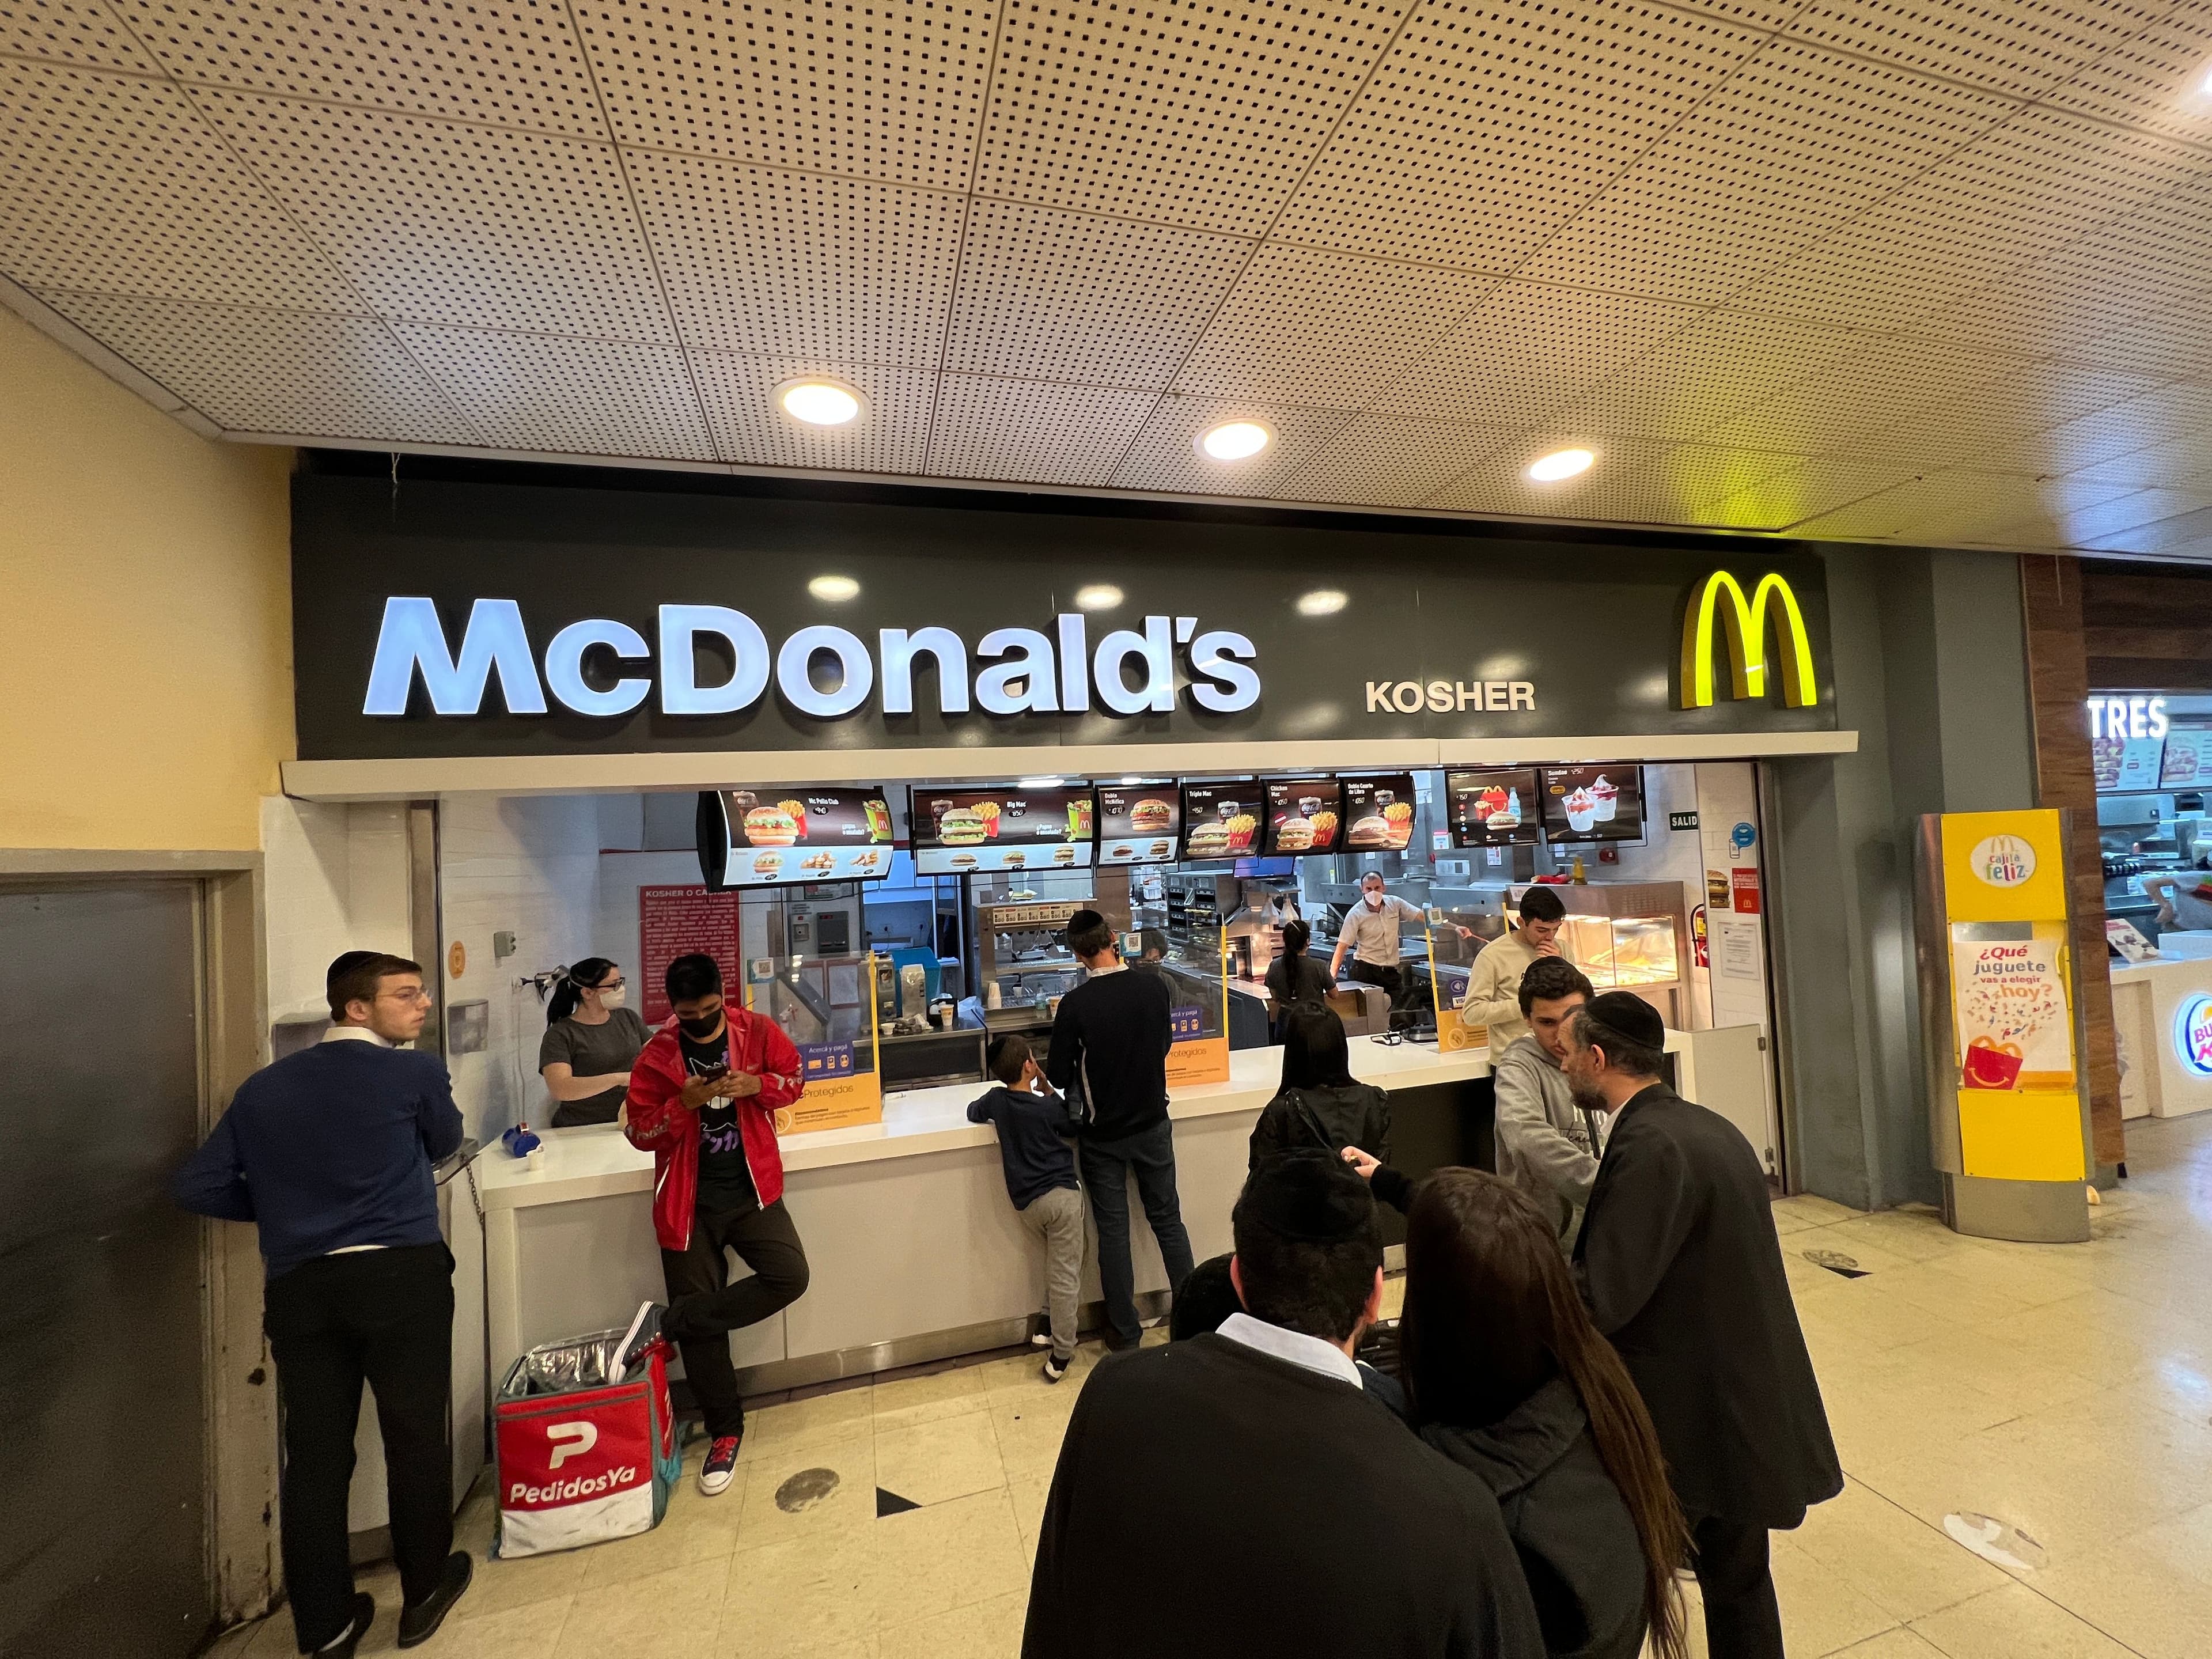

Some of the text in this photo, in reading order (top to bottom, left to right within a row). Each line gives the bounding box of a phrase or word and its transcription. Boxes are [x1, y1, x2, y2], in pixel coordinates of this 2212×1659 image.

[363, 597, 1262, 717] McDonald's
[1365, 681, 1536, 713] KOSHER
[1986, 863, 2026, 881] feliz
[1980, 945, 2028, 960] ¿Qué
[1973, 960, 2046, 975] juguete
[2009, 975, 2041, 984] elegir
[2000, 984, 2052, 1002] hoy?
[804, 1085, 854, 1097] Protegidos
[510, 1466, 635, 1503] PedidosYa
